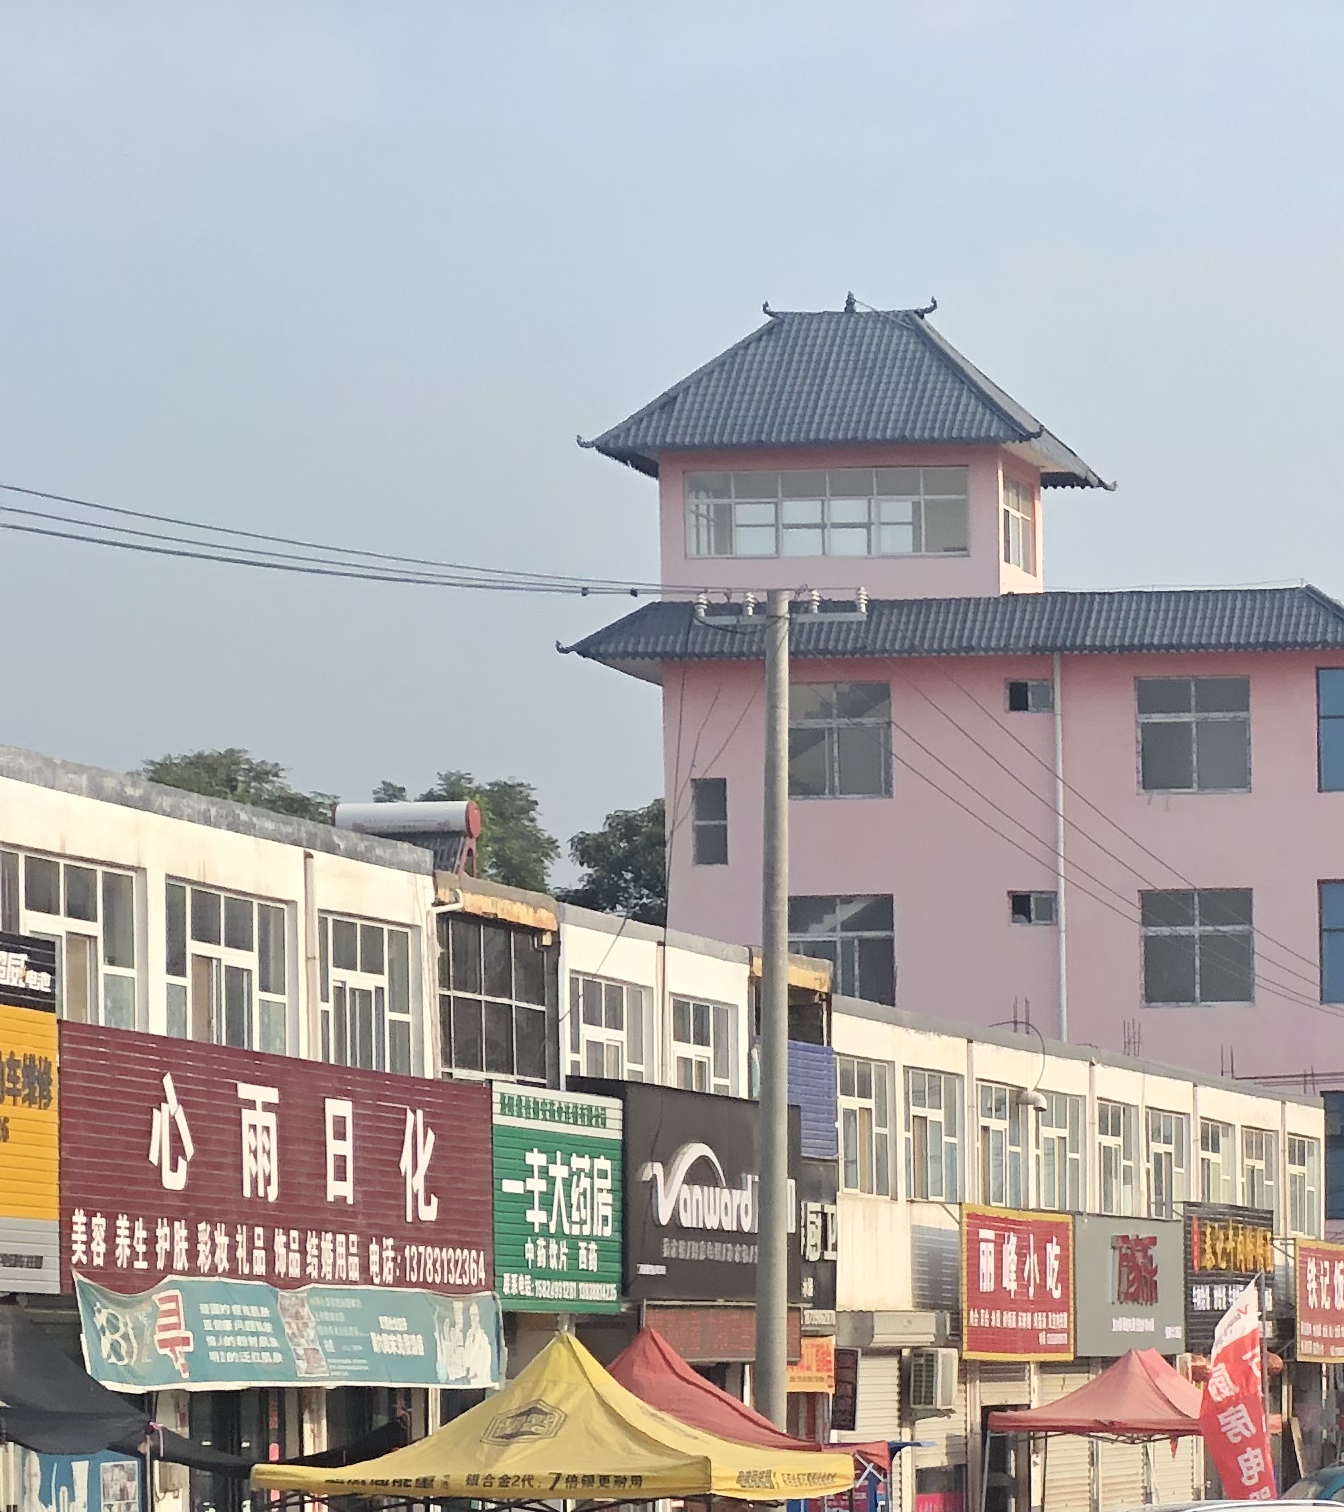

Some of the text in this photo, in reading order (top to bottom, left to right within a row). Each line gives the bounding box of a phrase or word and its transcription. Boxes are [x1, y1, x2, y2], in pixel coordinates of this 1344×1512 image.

[0, 1050, 52, 1110] 车维修
[149, 1072, 438, 1222] 心雨日化
[640, 1142, 759, 1233] Vanward
[502, 1148, 613, 1236] 一丰大药房
[71, 1208, 106, 1266] 美容
[115, 1213, 148, 1270] 养生
[155, 1216, 188, 1272] 护肤
[196, 1221, 229, 1274] 彩妆
[236, 1224, 266, 1277] 礼品
[274, 1228, 301, 1279] 饰品
[306, 1230, 360, 1283] 结婚用品
[525, 1237, 568, 1271] 中药饮片
